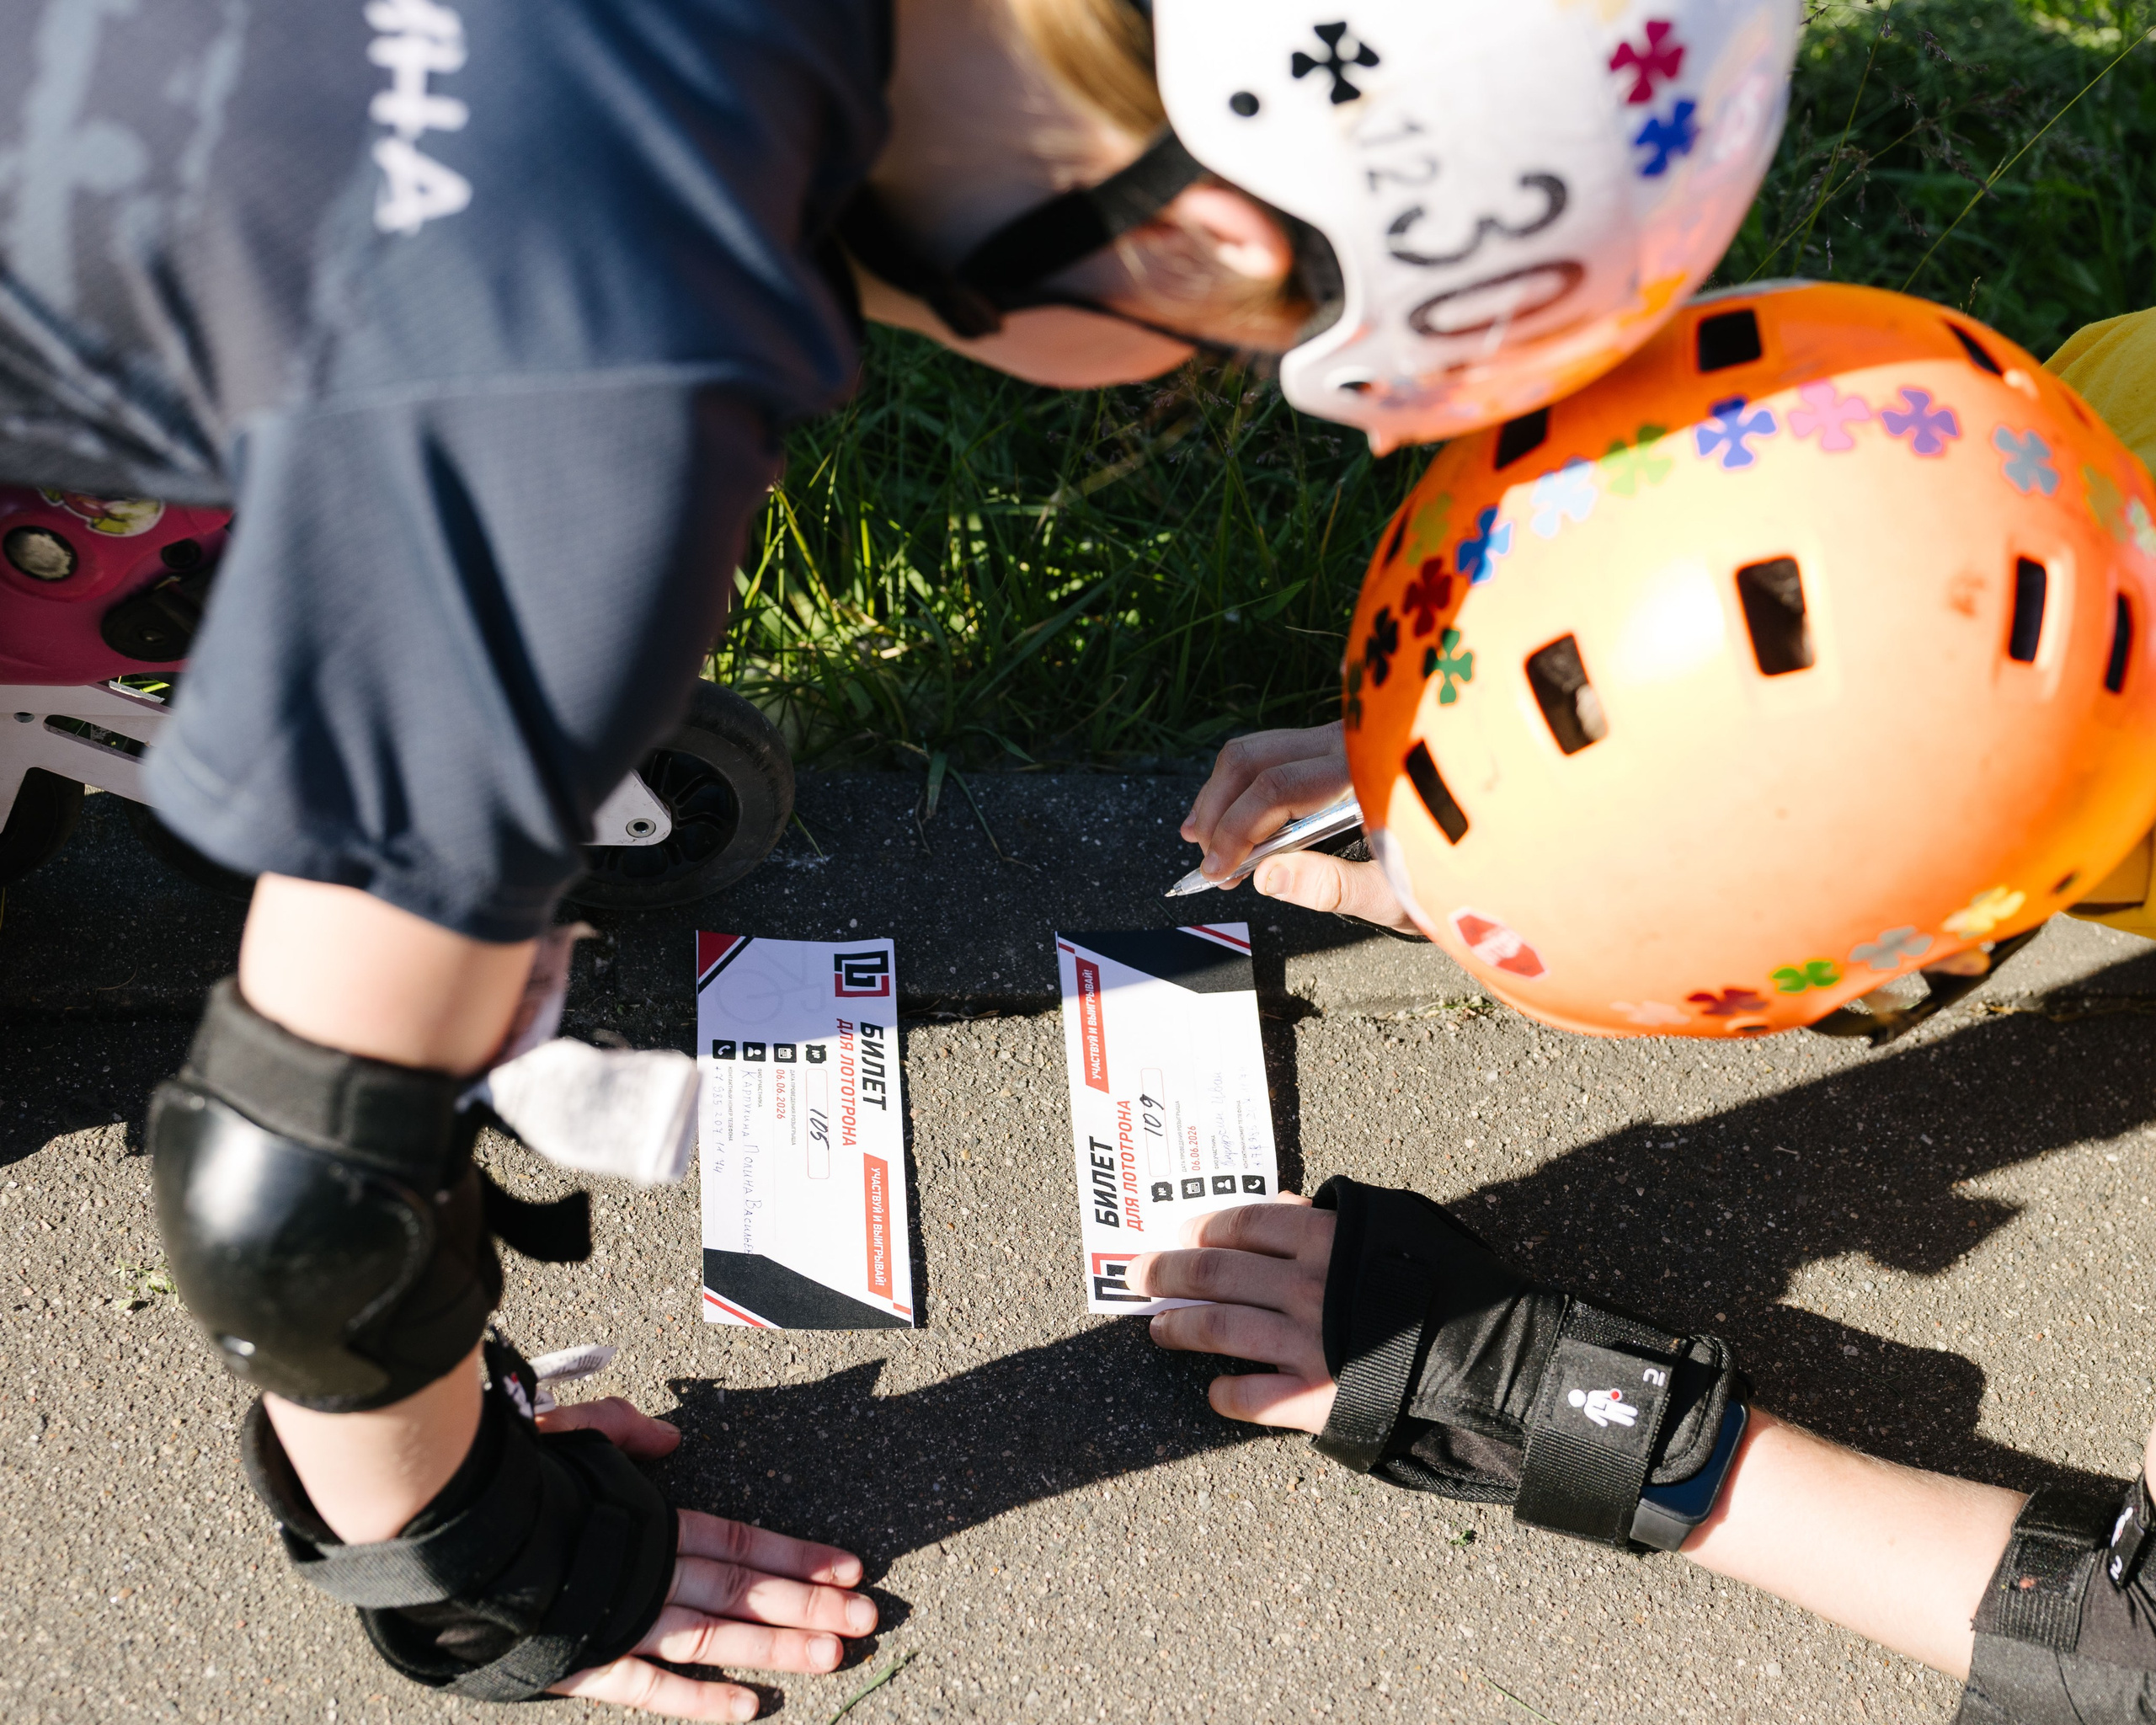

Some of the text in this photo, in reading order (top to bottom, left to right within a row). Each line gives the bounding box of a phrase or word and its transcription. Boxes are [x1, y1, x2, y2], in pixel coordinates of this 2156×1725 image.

[1082, 969, 1097, 1026] ВЫИГРЫВАЙ!
[836, 1018, 856, 1146] ДЛЯ ЛОТОТРОНА
[861, 1022, 886, 1110] БИЛЕТ
[1087, 1036, 1102, 1079] УЧАСТВУЙ
[776, 1070, 785, 1119] 06.06.2026
[1139, 1094, 1164, 1136] 109
[809, 1108, 830, 1151] 105
[1177, 1132, 1186, 1159] ПРОВЕДЕНИЯ
[1187, 1125, 1201, 1171] 06.06.2026
[871, 1167, 883, 1213] УЧАСТВУЙ
[1089, 1135, 1120, 1228] БИЛЕТ
[1117, 1101, 1144, 1231] ДЛЯ ЛОТОТРОНА
[873, 1224, 886, 1285] ВЫИГРЫВАЙ!
